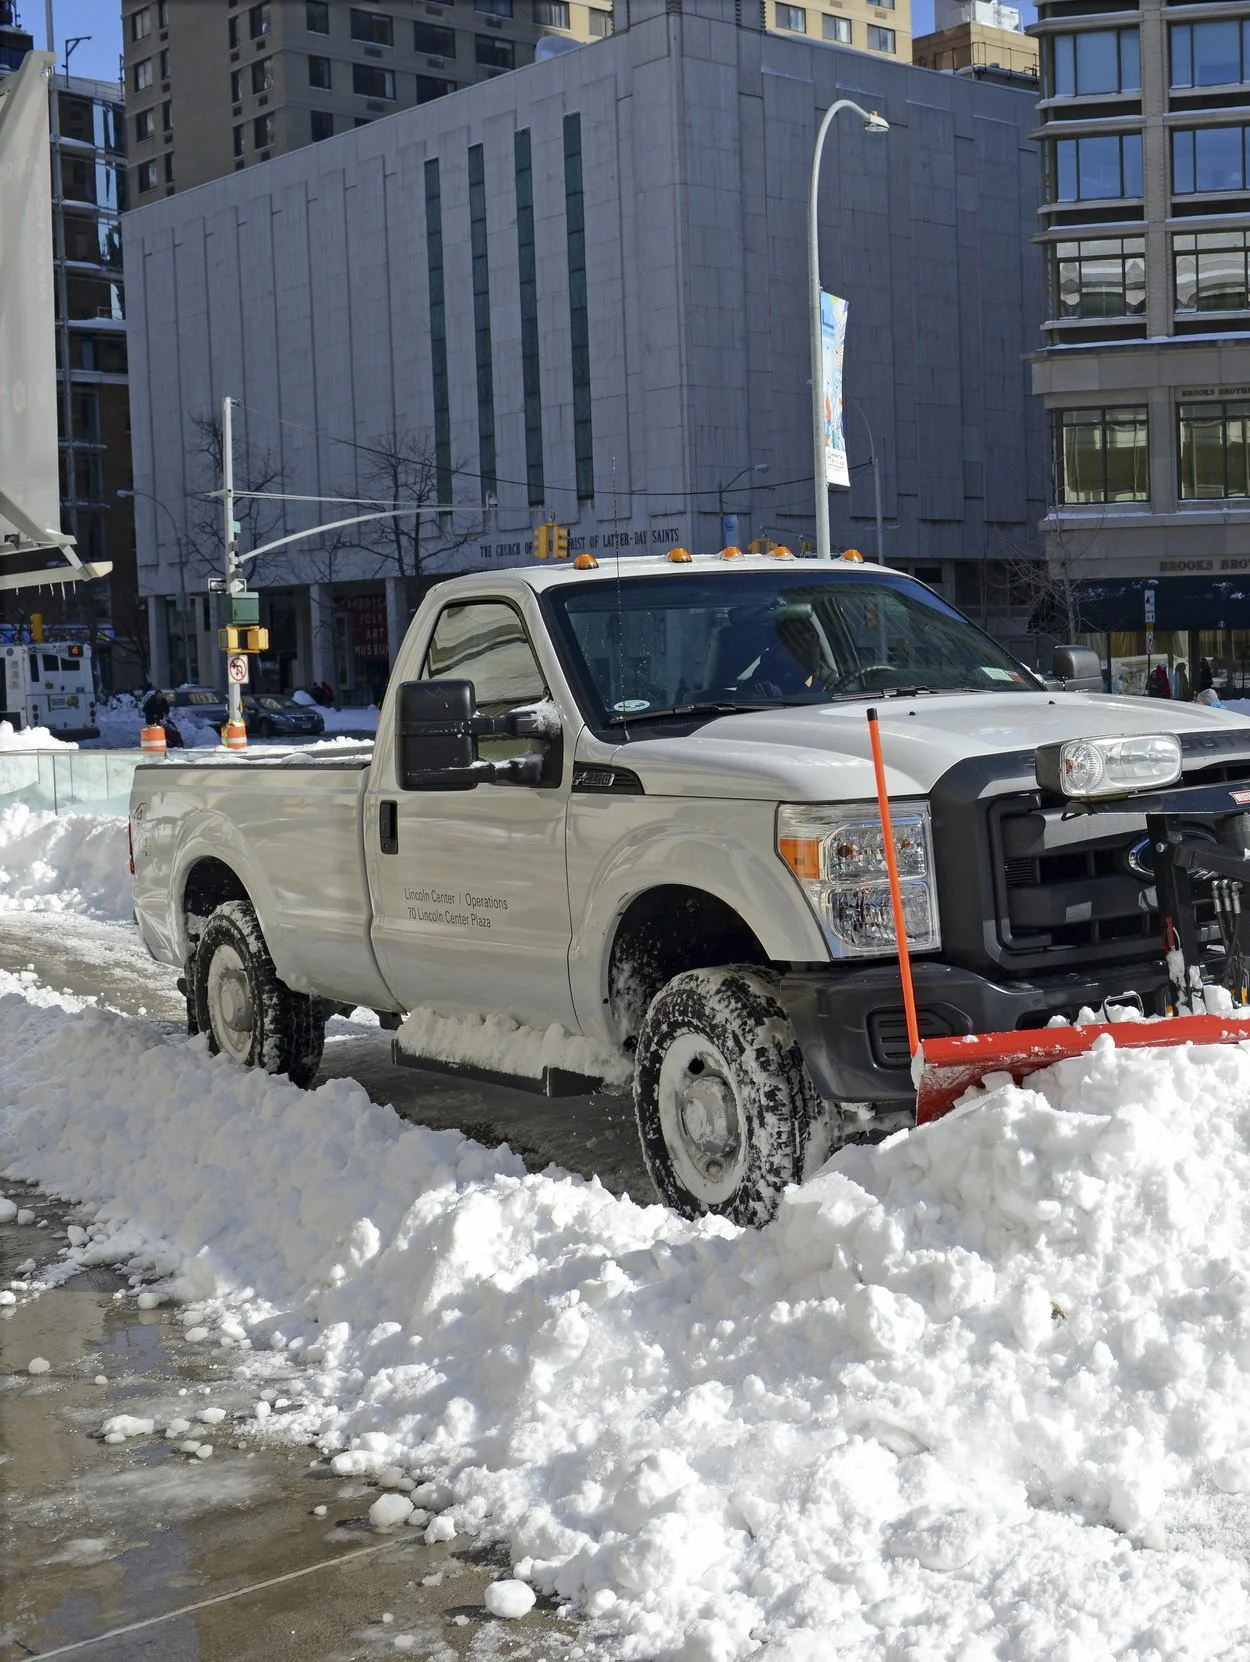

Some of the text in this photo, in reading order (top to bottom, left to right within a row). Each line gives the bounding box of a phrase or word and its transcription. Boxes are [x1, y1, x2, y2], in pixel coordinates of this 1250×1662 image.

[480, 545, 492, 558] THE
[495, 542, 521, 557] CHURCH
[524, 541, 533, 555] OF
[569, 536, 586, 550] RIST
[589, 535, 599, 549] OF
[602, 531, 647, 549] LATTER-DAY
[652, 527, 679, 544] SAINTS
[1160, 559, 1213, 572] BROOKS
[366, 628, 385, 640] ART
[404, 887, 430, 901] Lincoln
[431, 889, 455, 905] Center
[465, 892, 508, 910] Operations
[407, 906, 491, 928] 70 Lincoln Center Plaza
